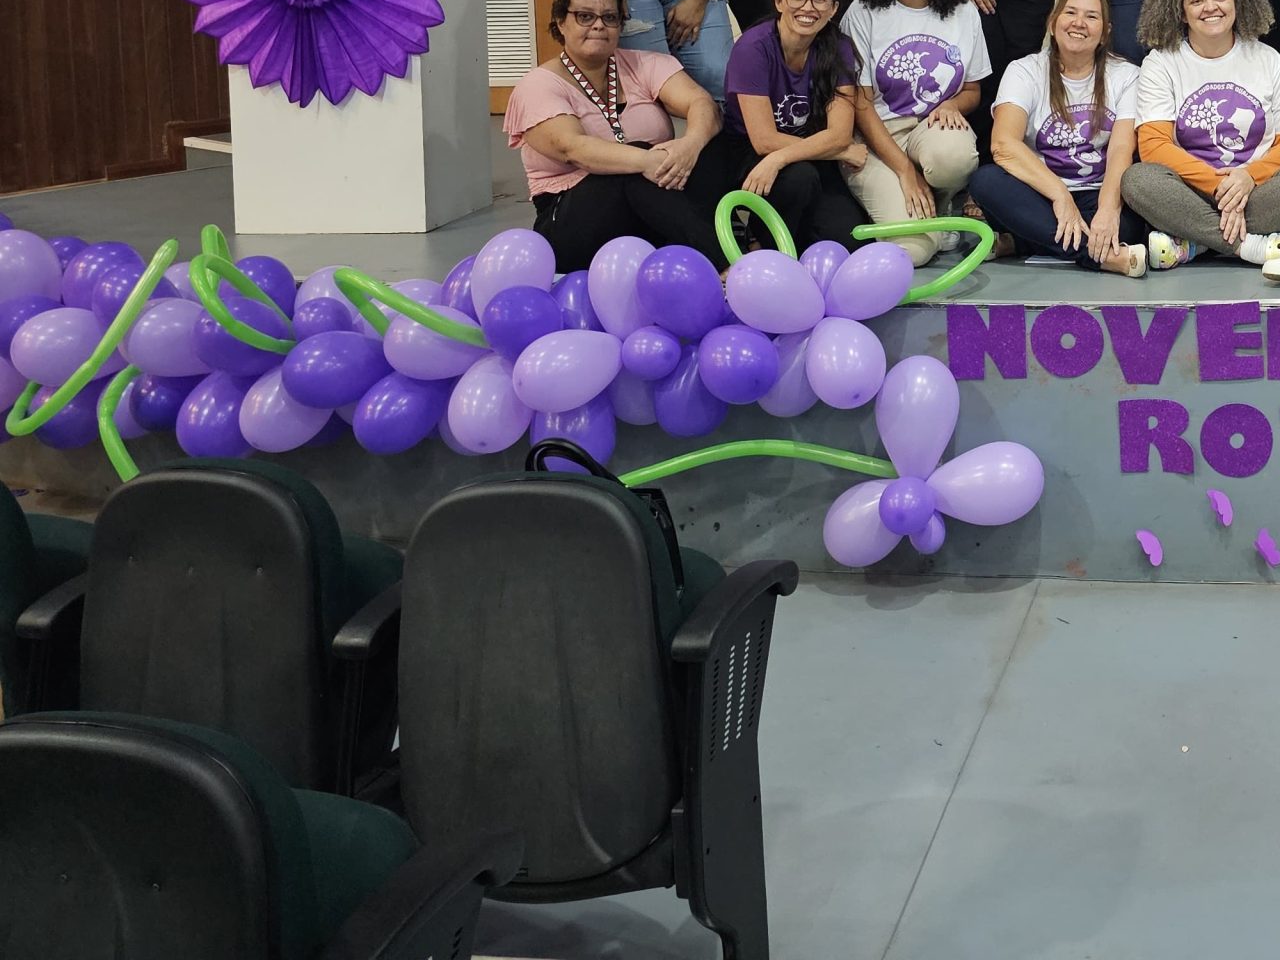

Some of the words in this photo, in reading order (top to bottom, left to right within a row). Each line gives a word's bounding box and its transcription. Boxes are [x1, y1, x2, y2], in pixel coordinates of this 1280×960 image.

[879, 46, 896, 69] ACESSO
[900, 35, 927, 46] CUIDADOS
[928, 36, 938, 44] DE
[1198, 83, 1225, 95] CUIDADOS
